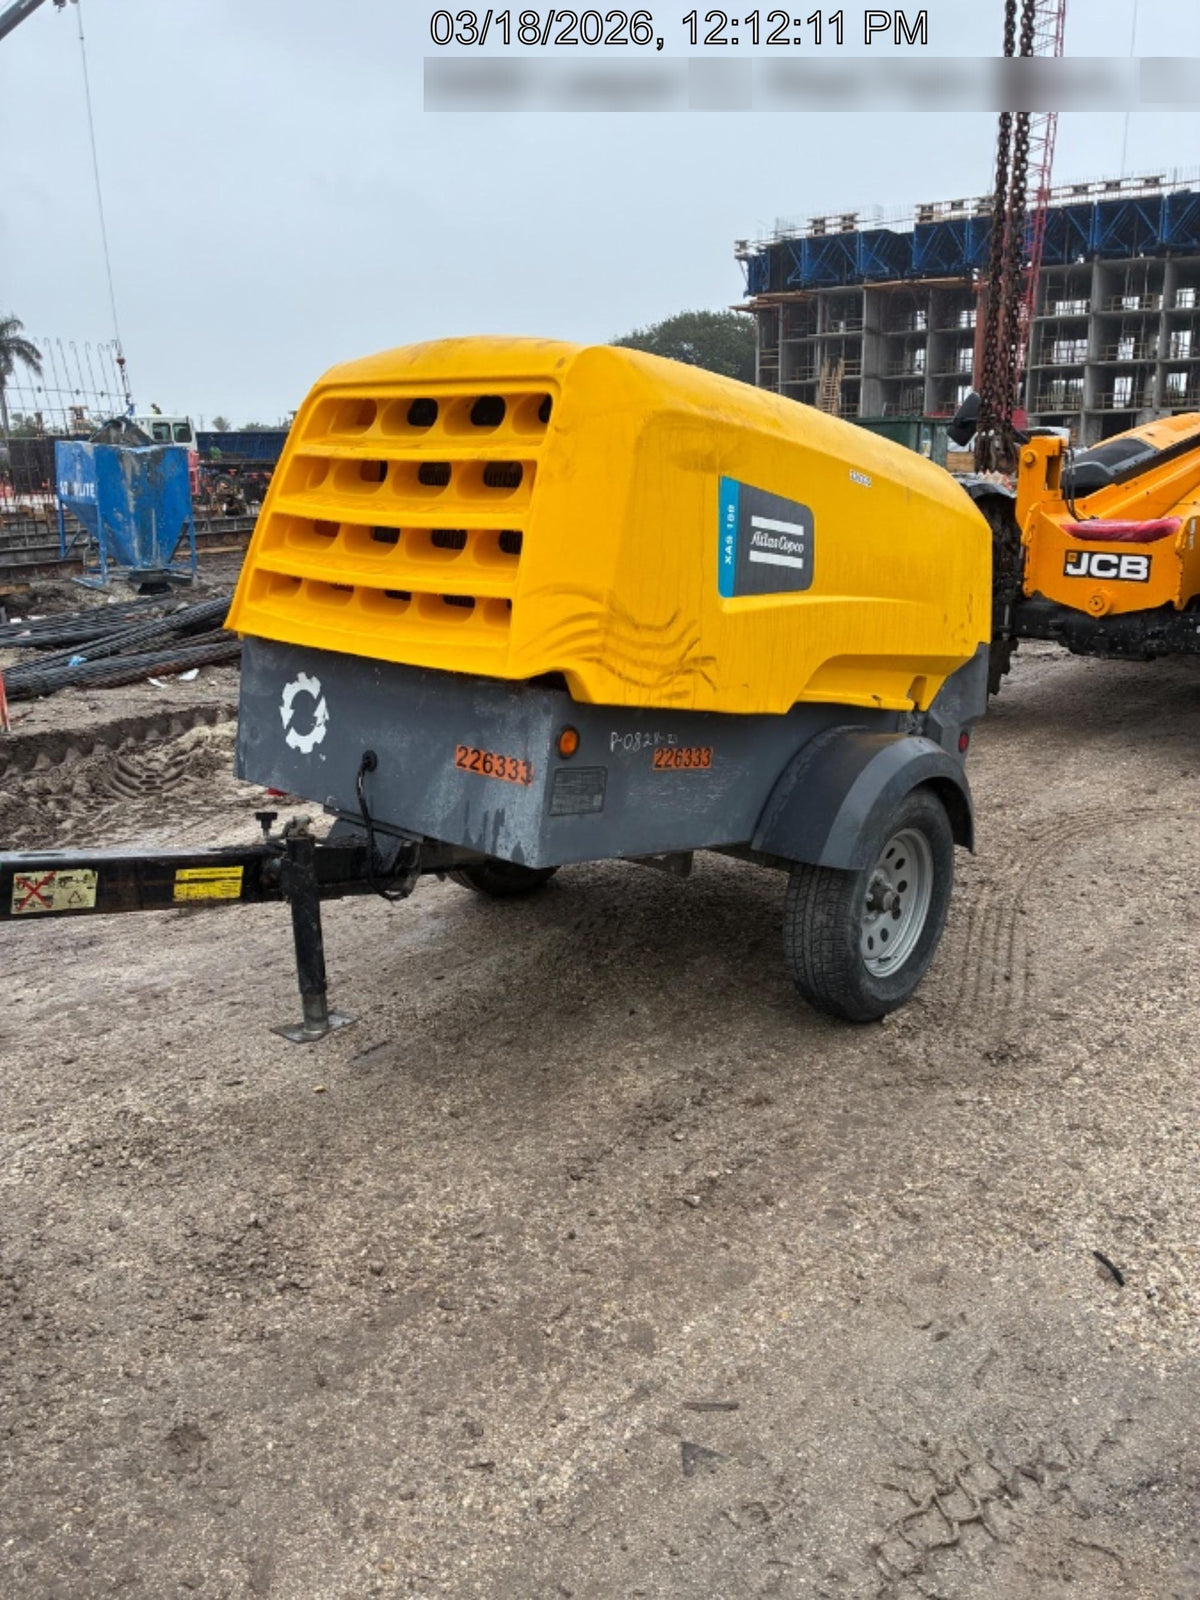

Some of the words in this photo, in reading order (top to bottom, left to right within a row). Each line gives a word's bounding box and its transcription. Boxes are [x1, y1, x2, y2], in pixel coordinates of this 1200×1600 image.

[725, 535, 734, 565] XAS
[779, 536, 804, 554] Copco
[1065, 551, 1150, 580] JCB
[456, 745, 534, 786] 226333
[654, 747, 712, 769] 226333
